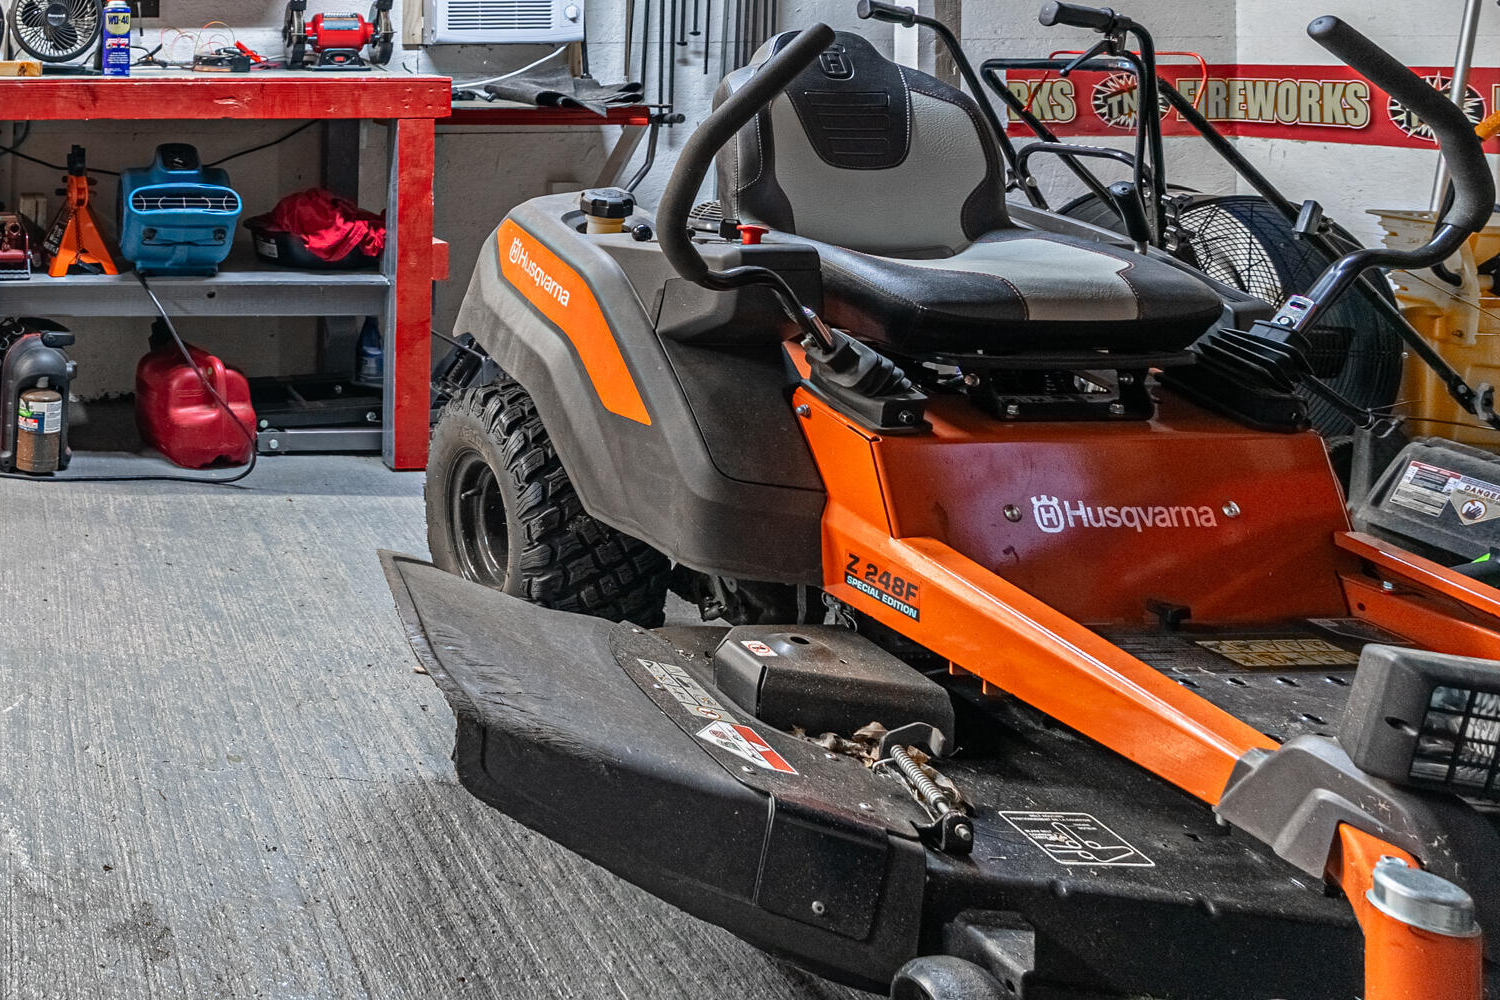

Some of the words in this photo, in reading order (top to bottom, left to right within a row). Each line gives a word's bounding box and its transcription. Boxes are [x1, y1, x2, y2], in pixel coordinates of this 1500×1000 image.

[107, 14, 130, 25] WD-40
[1179, 80, 1368, 126] FIREWORKS
[518, 247, 570, 308] Husqvarna
[1063, 500, 1218, 533] Husqvarna
[846, 552, 861, 574] Z
[865, 563, 918, 602] 248F
[846, 575, 880, 600] SPECIAL
[881, 593, 918, 619] EDITION
